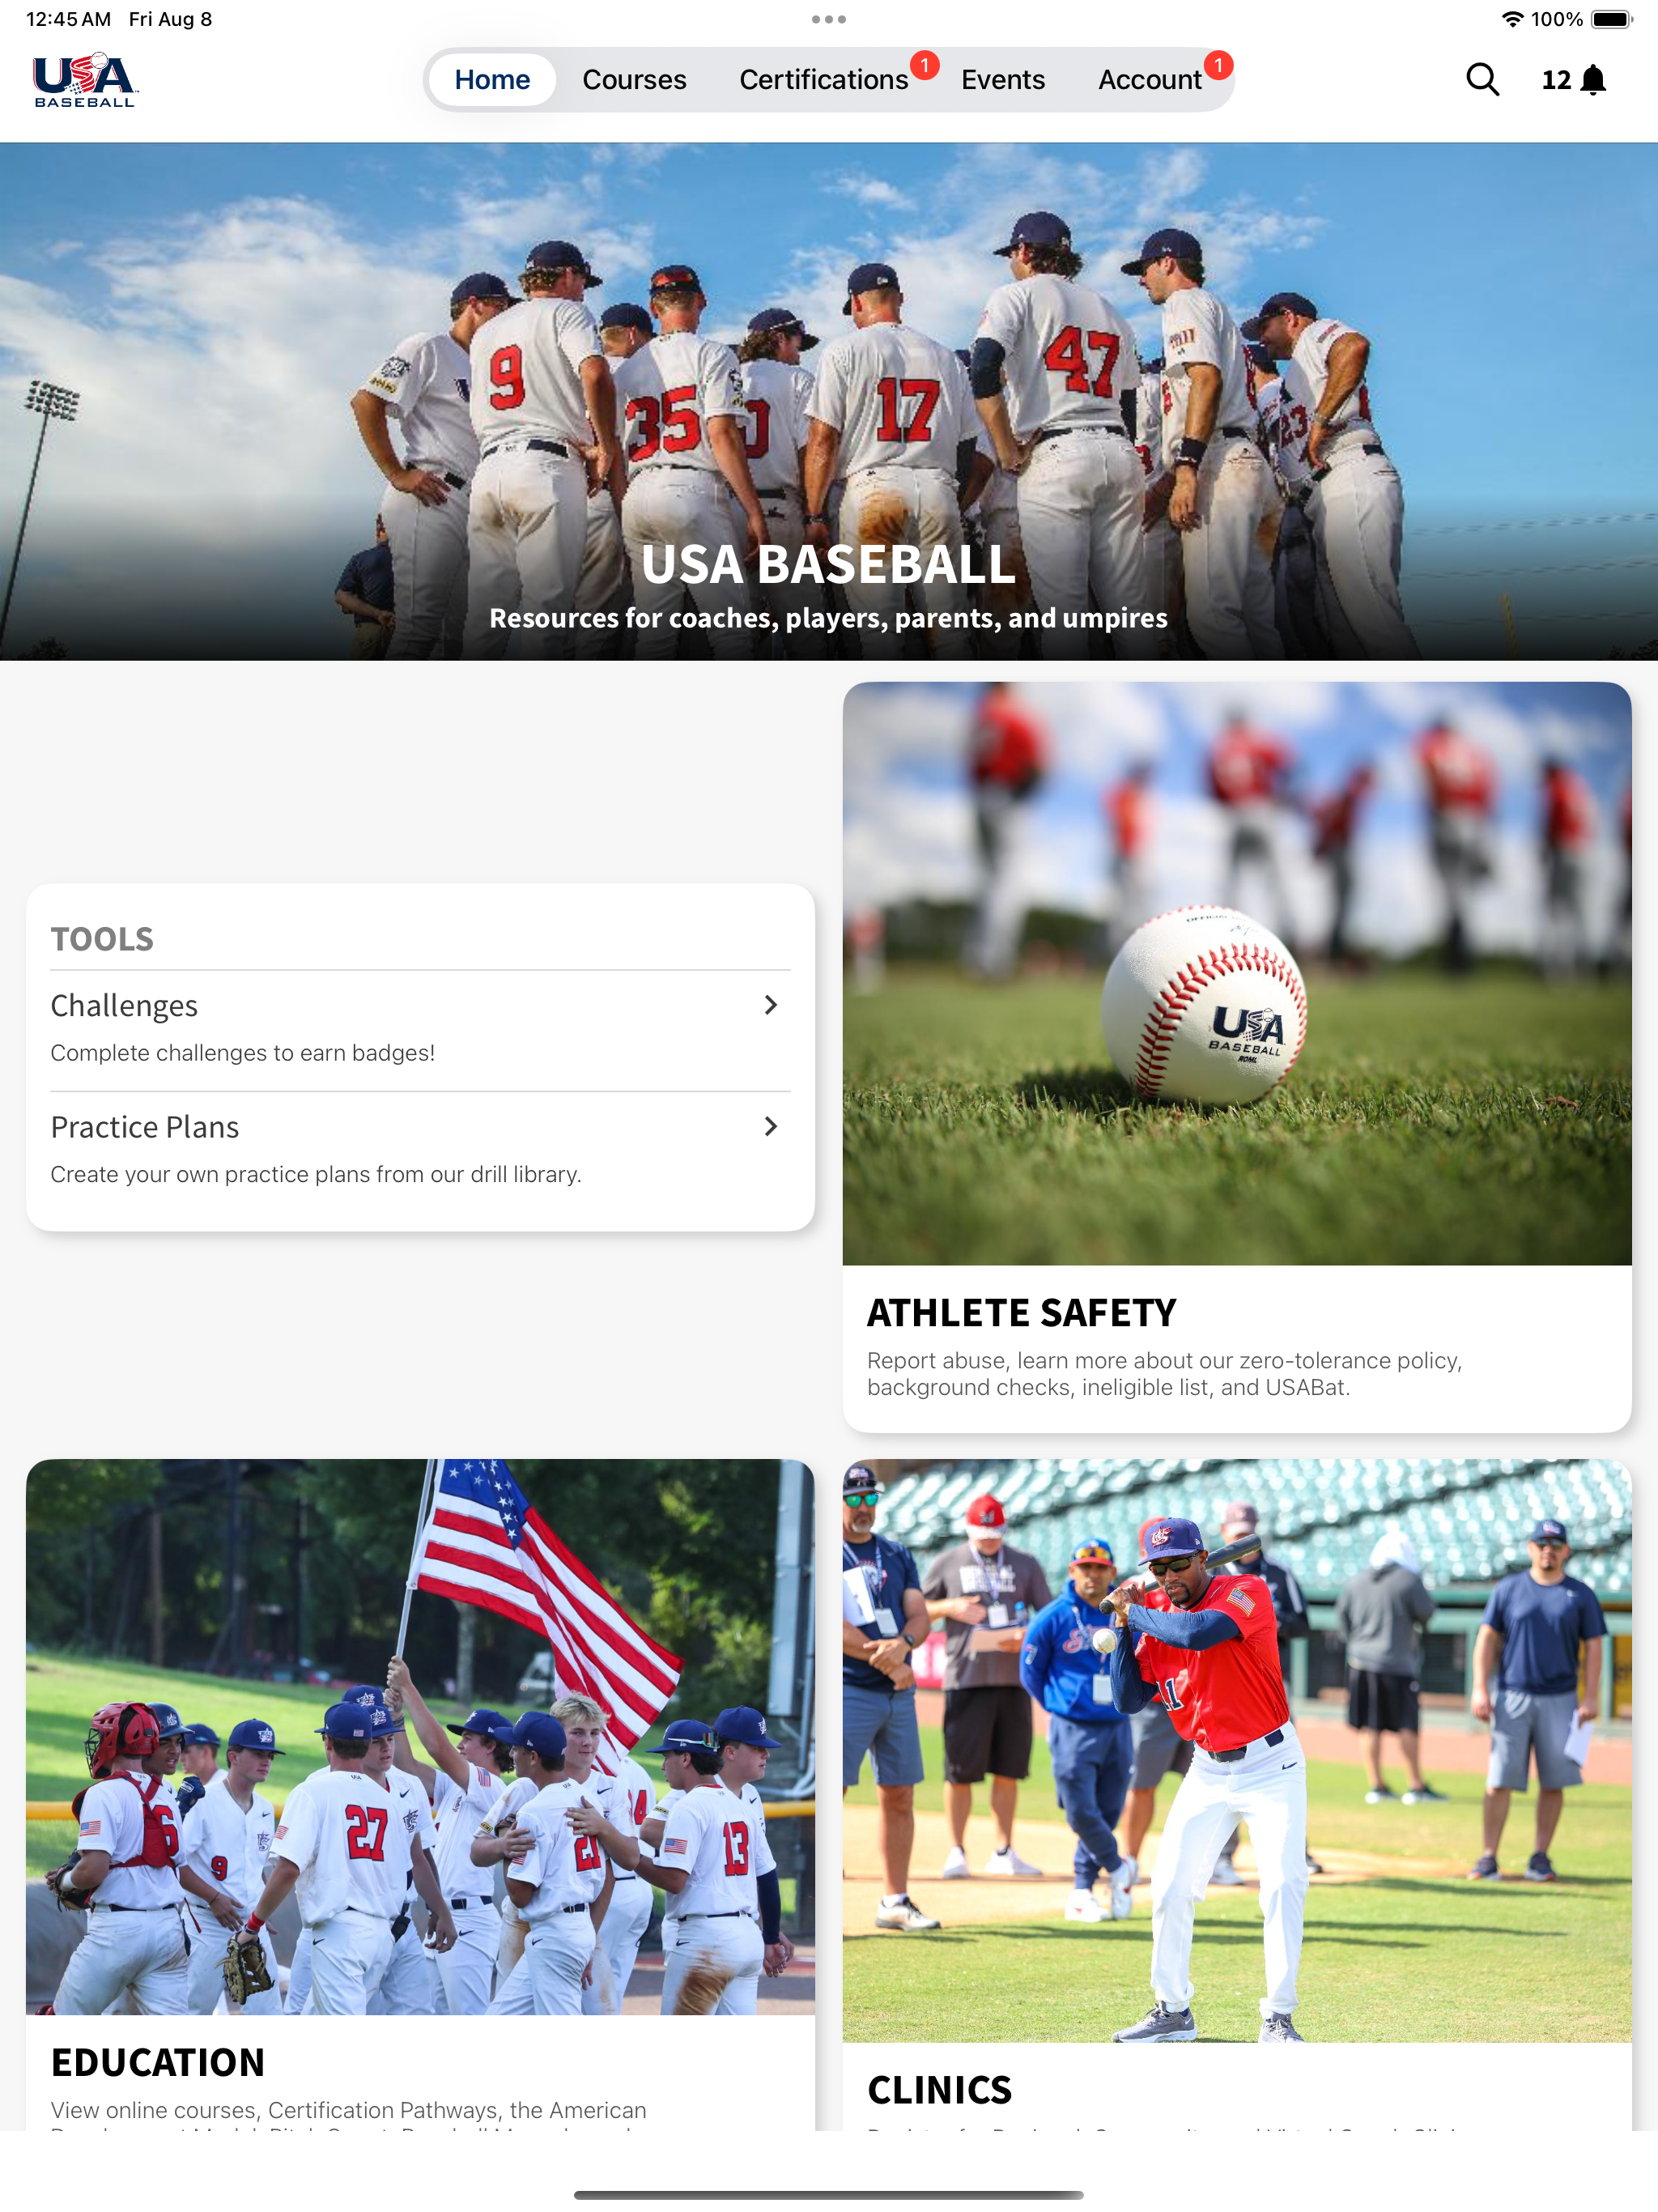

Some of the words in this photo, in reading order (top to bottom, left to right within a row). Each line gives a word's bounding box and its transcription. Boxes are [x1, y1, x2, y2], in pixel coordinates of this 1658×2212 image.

[27, 11, 77, 27] 12:45
[82, 11, 110, 27] AM
[130, 11, 151, 27] Fri
[158, 11, 193, 31] Aug
[201, 11, 213, 27] 8
[1532, 11, 1584, 28] 100%
[32, 52, 134, 93] USA
[921, 57, 928, 73] 1
[1215, 57, 1222, 73] 1
[457, 69, 531, 91] Home
[583, 68, 687, 91] Courses
[740, 67, 909, 91] Certifications
[963, 69, 1046, 91] Events
[1099, 69, 1203, 91] Account
[1543, 69, 1572, 90] 12
[35, 98, 134, 108] BASEBALL
[1044, 325, 1120, 398] 47
[490, 344, 525, 410] 9
[877, 377, 940, 442] 17
[625, 385, 702, 462] 35
[642, 543, 744, 585] USA
[759, 544, 1015, 585] BASEBALL
[490, 608, 619, 629] Resources
[625, 606, 663, 629] for
[670, 606, 779, 634] coaches,
[786, 606, 888, 635] players,
[896, 609, 1002, 635] parents,
[1009, 606, 1056, 629] and
[1063, 606, 1168, 634] umpires
[51, 926, 154, 952] TOOLS
[51, 992, 198, 1023] Challenges
[1213, 1006, 1285, 1045] USA
[51, 1044, 150, 1066] Complete
[156, 1043, 267, 1066] challenges
[273, 1044, 294, 1062] to
[300, 1048, 346, 1062] earn
[353, 1043, 435, 1066] badges!
[1209, 1040, 1281, 1056] BASEBALL
[52, 1114, 159, 1139] Practice
[167, 1113, 240, 1139] Plans
[51, 1165, 119, 1184] Create
[125, 1169, 171, 1187] your
[176, 1169, 219, 1184] own
[226, 1166, 309, 1187] practice
[316, 1164, 371, 1187] plans
[376, 1164, 423, 1184] from
[431, 1169, 465, 1184] our
[470, 1164, 507, 1184] drill
[514, 1164, 581, 1187] library.
[866, 1298, 1030, 1327] ATHLETE
[1040, 1297, 1178, 1328] SAFETY
[868, 1351, 937, 1373] Report
[942, 1351, 1010, 1373] abuse,
[1018, 1351, 1068, 1370] learn
[1076, 1355, 1128, 1370] more
[1133, 1351, 1193, 1370] about
[1199, 1355, 1234, 1370] our
[1239, 1351, 1392, 1370] zero-tolerance
[1398, 1351, 1462, 1374] policy,
[868, 1377, 989, 1400] background
[997, 1377, 1074, 1400] checks,
[1082, 1377, 1173, 1400] ineligible
[1180, 1377, 1214, 1400] list,
[1221, 1377, 1259, 1397] and
[1266, 1377, 1350, 1397] USABat.
[345, 1804, 389, 1862] 27
[723, 1820, 749, 1869] 13
[211, 1852, 228, 1882] 9
[53, 2047, 265, 2078] EDUCATION
[868, 2074, 1012, 2105] CLINICS
[50, 2101, 100, 2120] View
[106, 2100, 168, 2120] online
[174, 2105, 261, 2123] courses,
[269, 2100, 393, 2120] Certification
[401, 2100, 504, 2124] Pathways,
[509, 2100, 543, 2120] the
[549, 2101, 647, 2120] American
